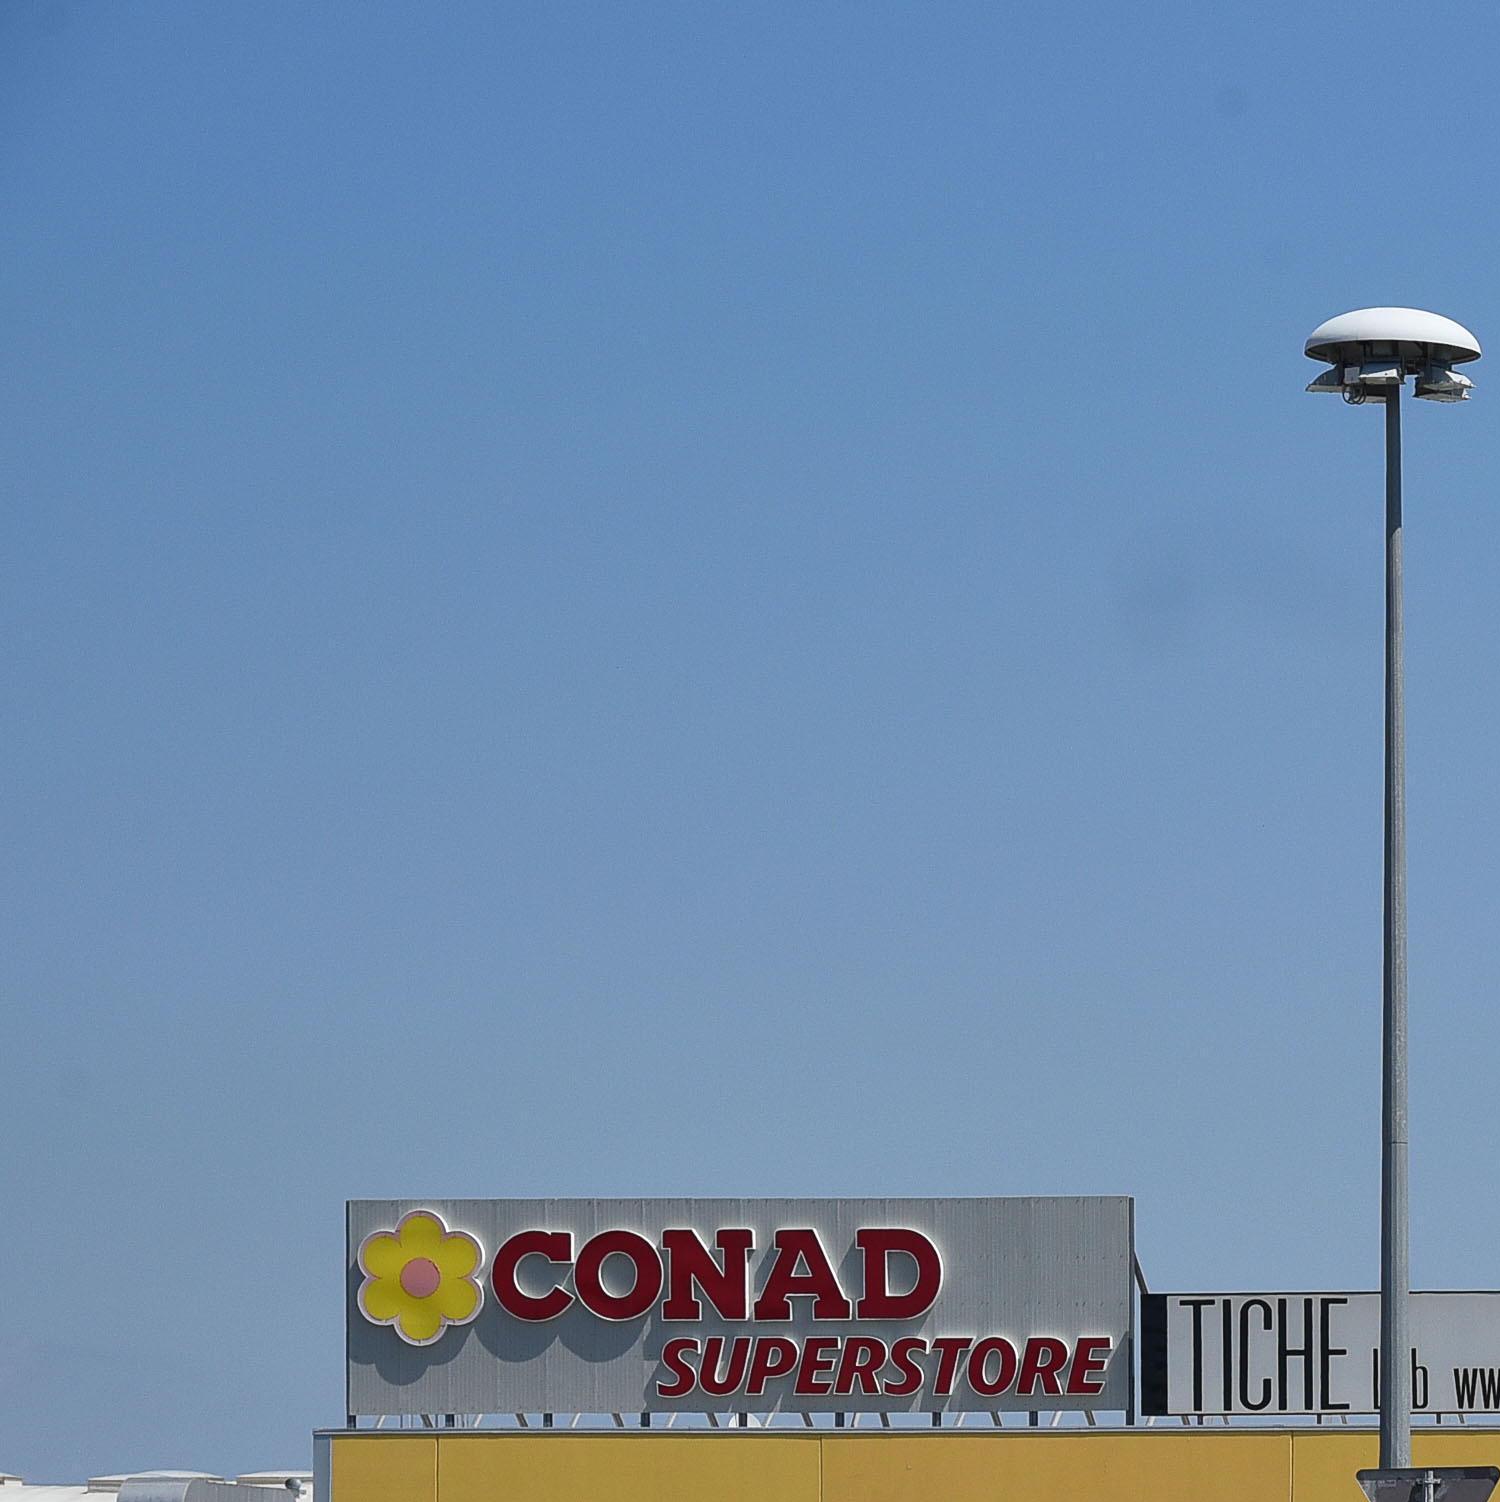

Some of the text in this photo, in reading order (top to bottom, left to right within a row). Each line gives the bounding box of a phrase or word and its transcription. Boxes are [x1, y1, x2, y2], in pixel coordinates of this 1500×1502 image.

[490, 1226, 943, 1322] CONAD
[656, 1335, 1114, 1398] SUPERSTORE
[1178, 1297, 1349, 1411] TICHE
